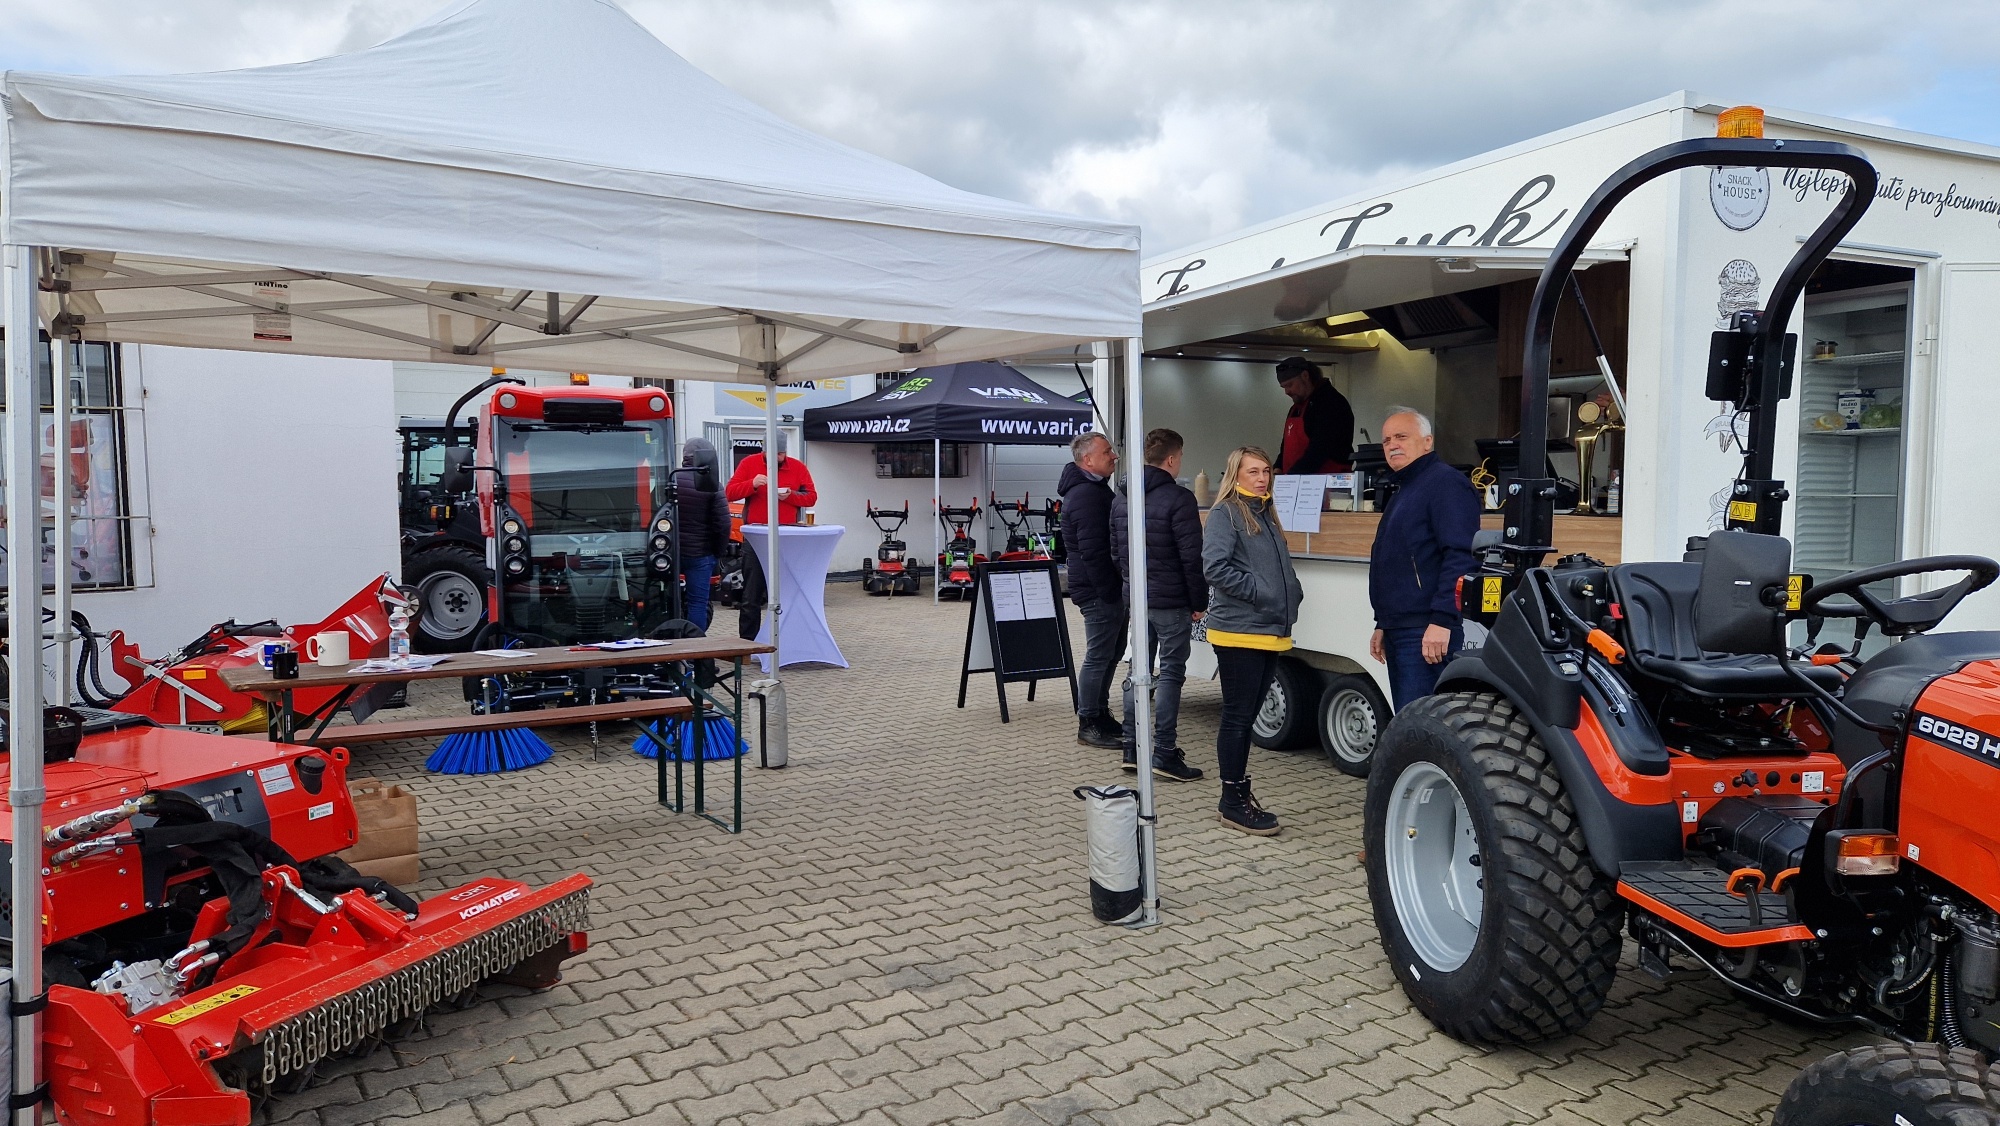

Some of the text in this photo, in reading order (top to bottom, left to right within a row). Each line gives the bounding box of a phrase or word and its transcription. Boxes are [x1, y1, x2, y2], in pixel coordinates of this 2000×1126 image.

[1727, 173, 1753, 186] SNACK
[1723, 186, 1757, 200] HOUSE
[1783, 166, 2000, 229] Nejlepš utě prozkoumán
[967, 387, 1044, 401] VARI
[826, 415, 911, 434] www.vari.cz
[733, 440, 763, 448] KOMA
[1918, 715, 1980, 750] 6028
[449, 884, 490, 901] FORT
[459, 887, 522, 920] KOMATEC
